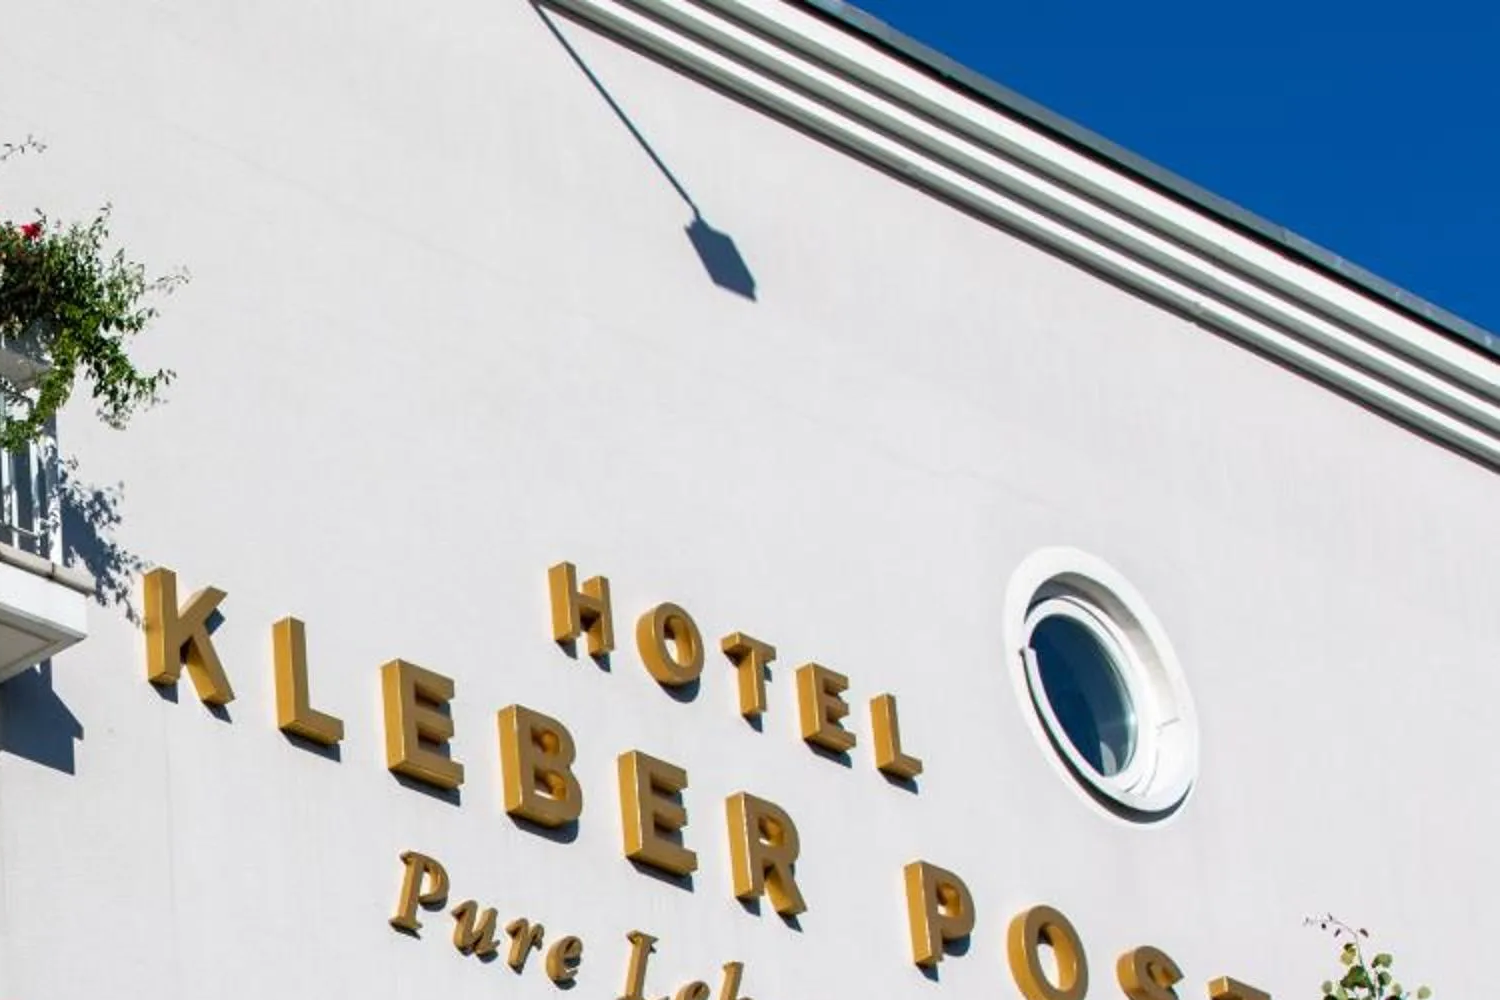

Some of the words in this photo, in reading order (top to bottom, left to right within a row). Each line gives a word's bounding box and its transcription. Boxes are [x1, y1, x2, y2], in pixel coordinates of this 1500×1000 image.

[143, 566, 806, 921] KLEBER
[548, 561, 923, 782] HOTEL
[390, 850, 584, 986] Pure
